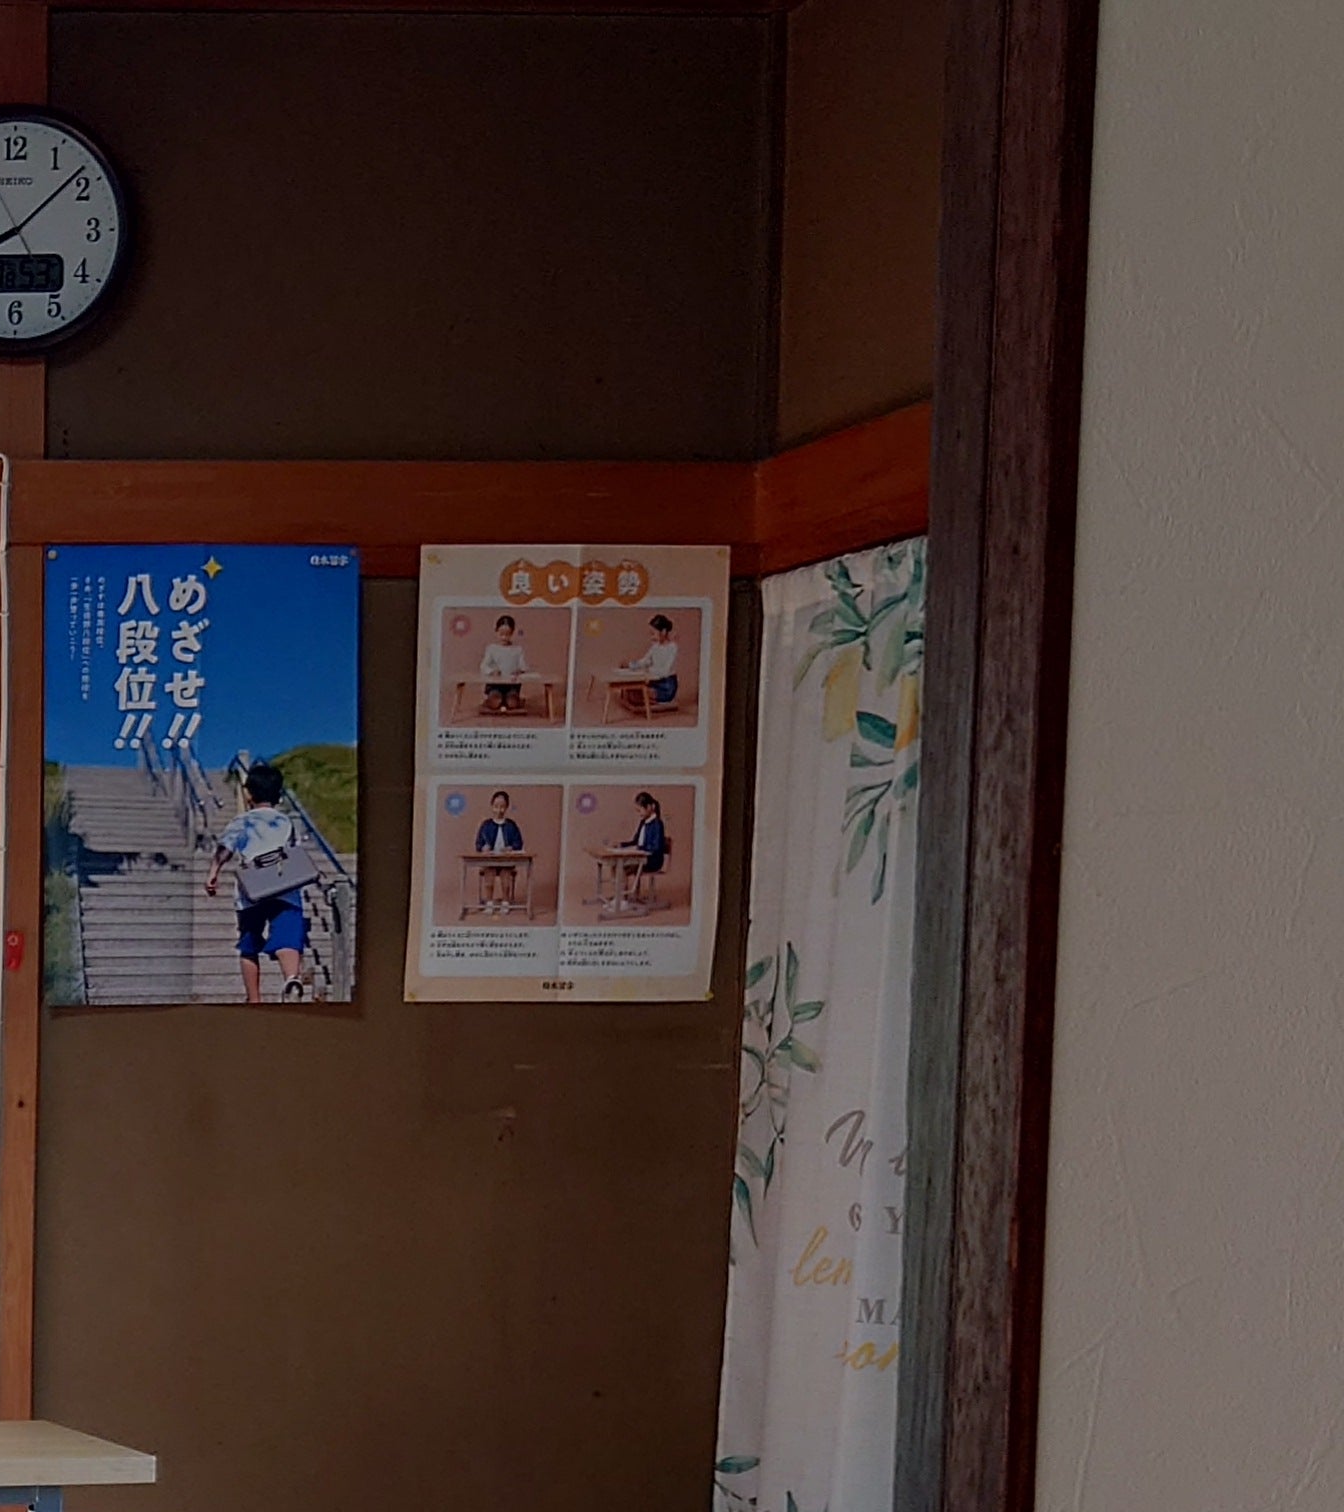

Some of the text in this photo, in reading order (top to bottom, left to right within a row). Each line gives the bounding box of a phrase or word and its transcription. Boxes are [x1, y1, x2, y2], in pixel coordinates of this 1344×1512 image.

[4, 136, 28, 161] 12
[50, 147, 60, 170] 1
[75, 177, 90, 201] 2
[86, 217, 100, 242] 3
[74, 258, 90, 283] 4
[8, 300, 23, 325] 6
[47, 294, 61, 317] 5
[508, 571, 641, 596] 良い姿勢
